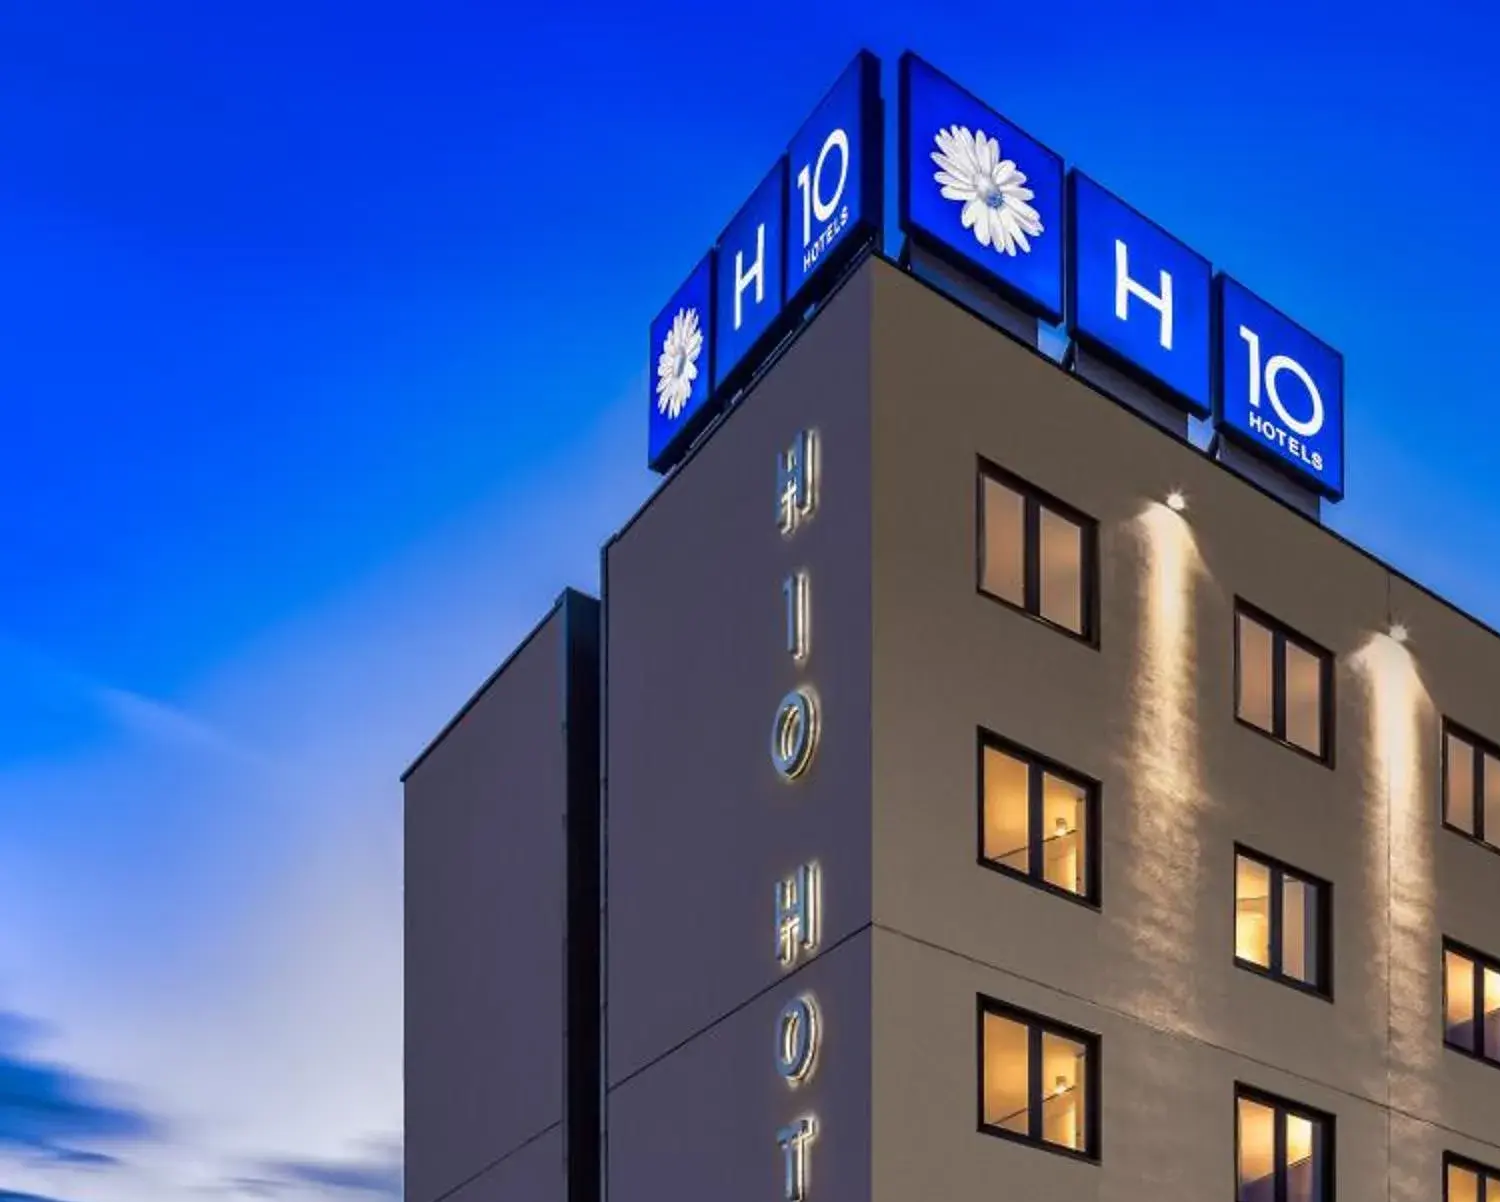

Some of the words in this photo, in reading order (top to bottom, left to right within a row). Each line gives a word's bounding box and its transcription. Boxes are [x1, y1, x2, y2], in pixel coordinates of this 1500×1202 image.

[797, 128, 849, 247] 10
[803, 205, 848, 272] HOTELS
[1239, 324, 1324, 437] 10
[1249, 411, 1323, 471] HOTELS
[771, 427, 821, 780] H10
